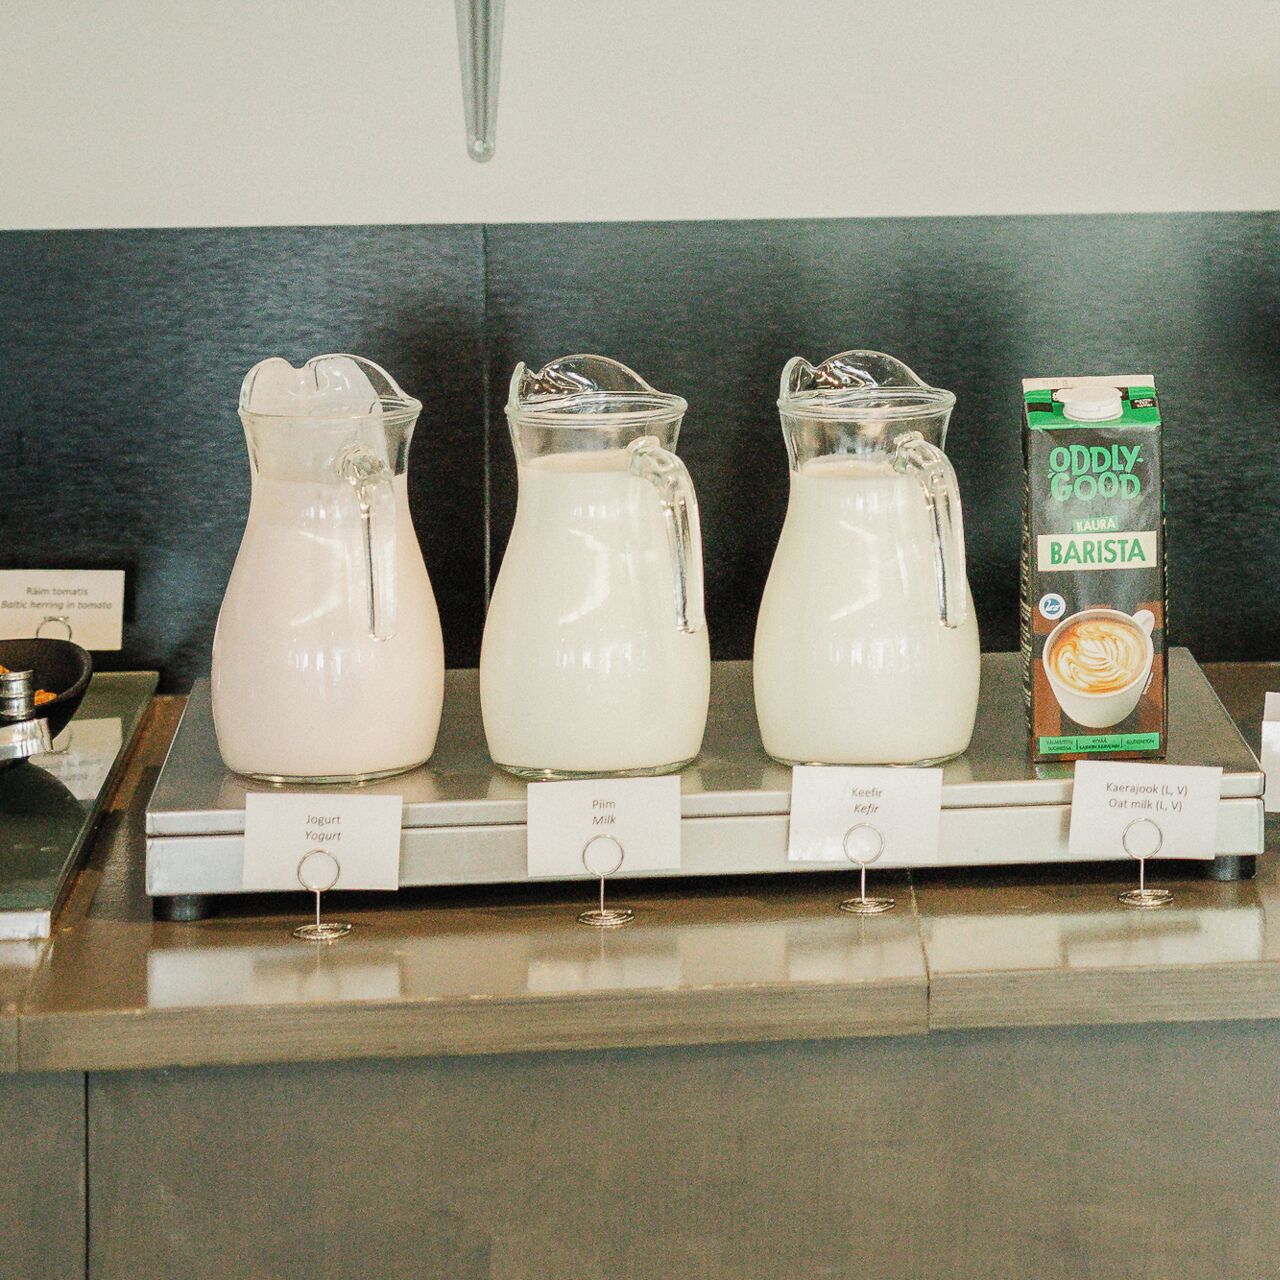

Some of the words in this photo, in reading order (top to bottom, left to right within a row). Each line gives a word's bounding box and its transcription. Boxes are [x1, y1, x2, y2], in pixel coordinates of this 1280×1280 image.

[1049, 444, 1141, 476] ODDLY
[1050, 471, 1141, 501] GOOD
[1076, 518, 1116, 532] KAURA
[1050, 538, 1146, 565] BARISTA
[52, 587, 88, 596] tomatis
[1, 600, 27, 609] Baltic
[30, 601, 64, 611] herring
[66, 601, 75, 609] in
[78, 602, 112, 610] tomato
[851, 786, 883, 798] Keefir
[1106, 782, 1158, 795] Kaerajook
[1161, 784, 1174, 797] (L,
[1177, 785, 1188, 797] V)
[592, 799, 616, 809] Piim
[853, 803, 879, 816] Kefir
[1108, 798, 1128, 808] Oat
[1131, 799, 1153, 809] milk
[1156, 800, 1168, 812] (L,
[1171, 801, 1183, 813] V)
[306, 815, 341, 827] Jogurt
[592, 815, 616, 825] Milk
[305, 831, 341, 843] Yogurt
